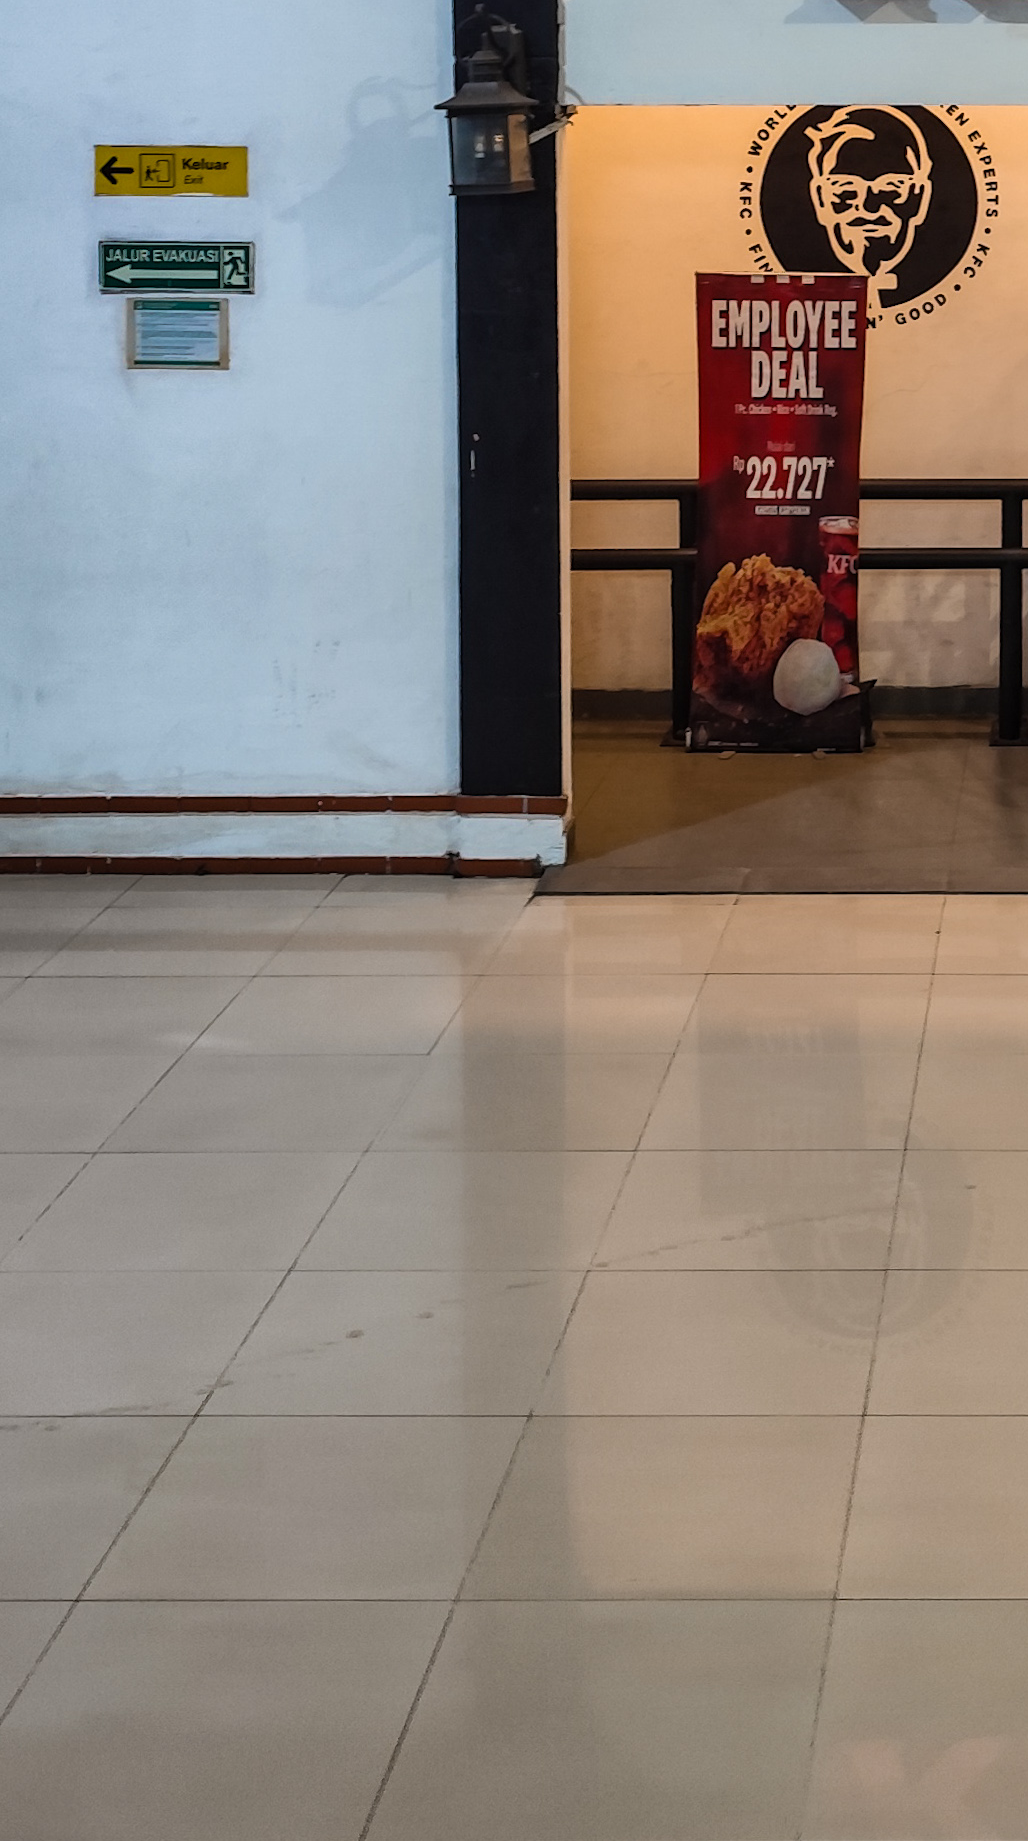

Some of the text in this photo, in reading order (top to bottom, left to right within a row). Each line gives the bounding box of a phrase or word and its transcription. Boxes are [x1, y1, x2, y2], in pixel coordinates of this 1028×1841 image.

[182, 158, 229, 171] Keluar
[940, 104, 999, 218] EN EXPERTS
[184, 175, 204, 185] Exit
[739, 181, 752, 219] KFC
[106, 248, 219, 263] JALUR EVAKUASI
[963, 243, 990, 278] KFC
[711, 299, 858, 349] EMPLOYEE
[894, 293, 947, 325] GOOD
[751, 350, 824, 399] DEAL
